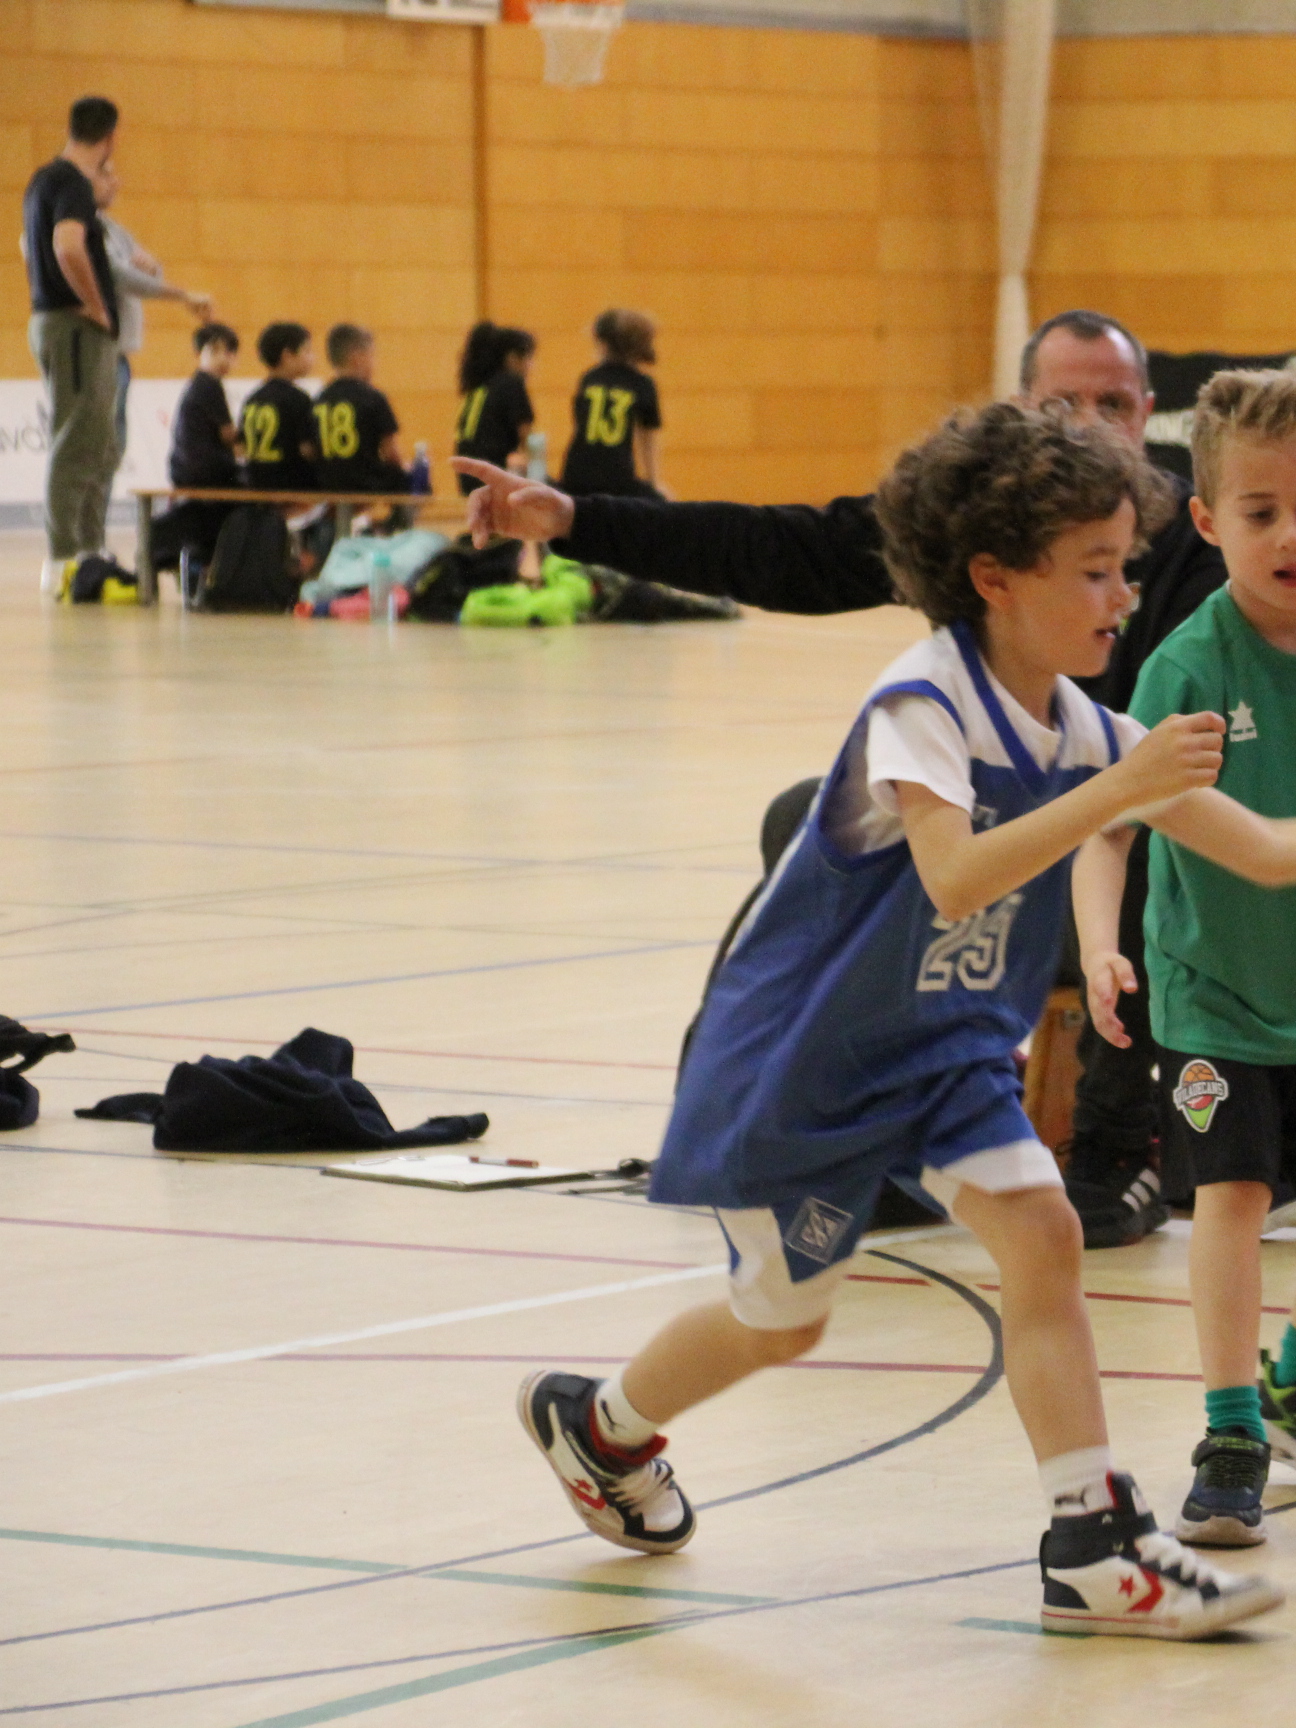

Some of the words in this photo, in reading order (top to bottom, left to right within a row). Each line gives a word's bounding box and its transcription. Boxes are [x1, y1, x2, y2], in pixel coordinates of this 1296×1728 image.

[244, 403, 283, 463] 12
[312, 402, 359, 459] 18
[585, 385, 633, 444] 13
